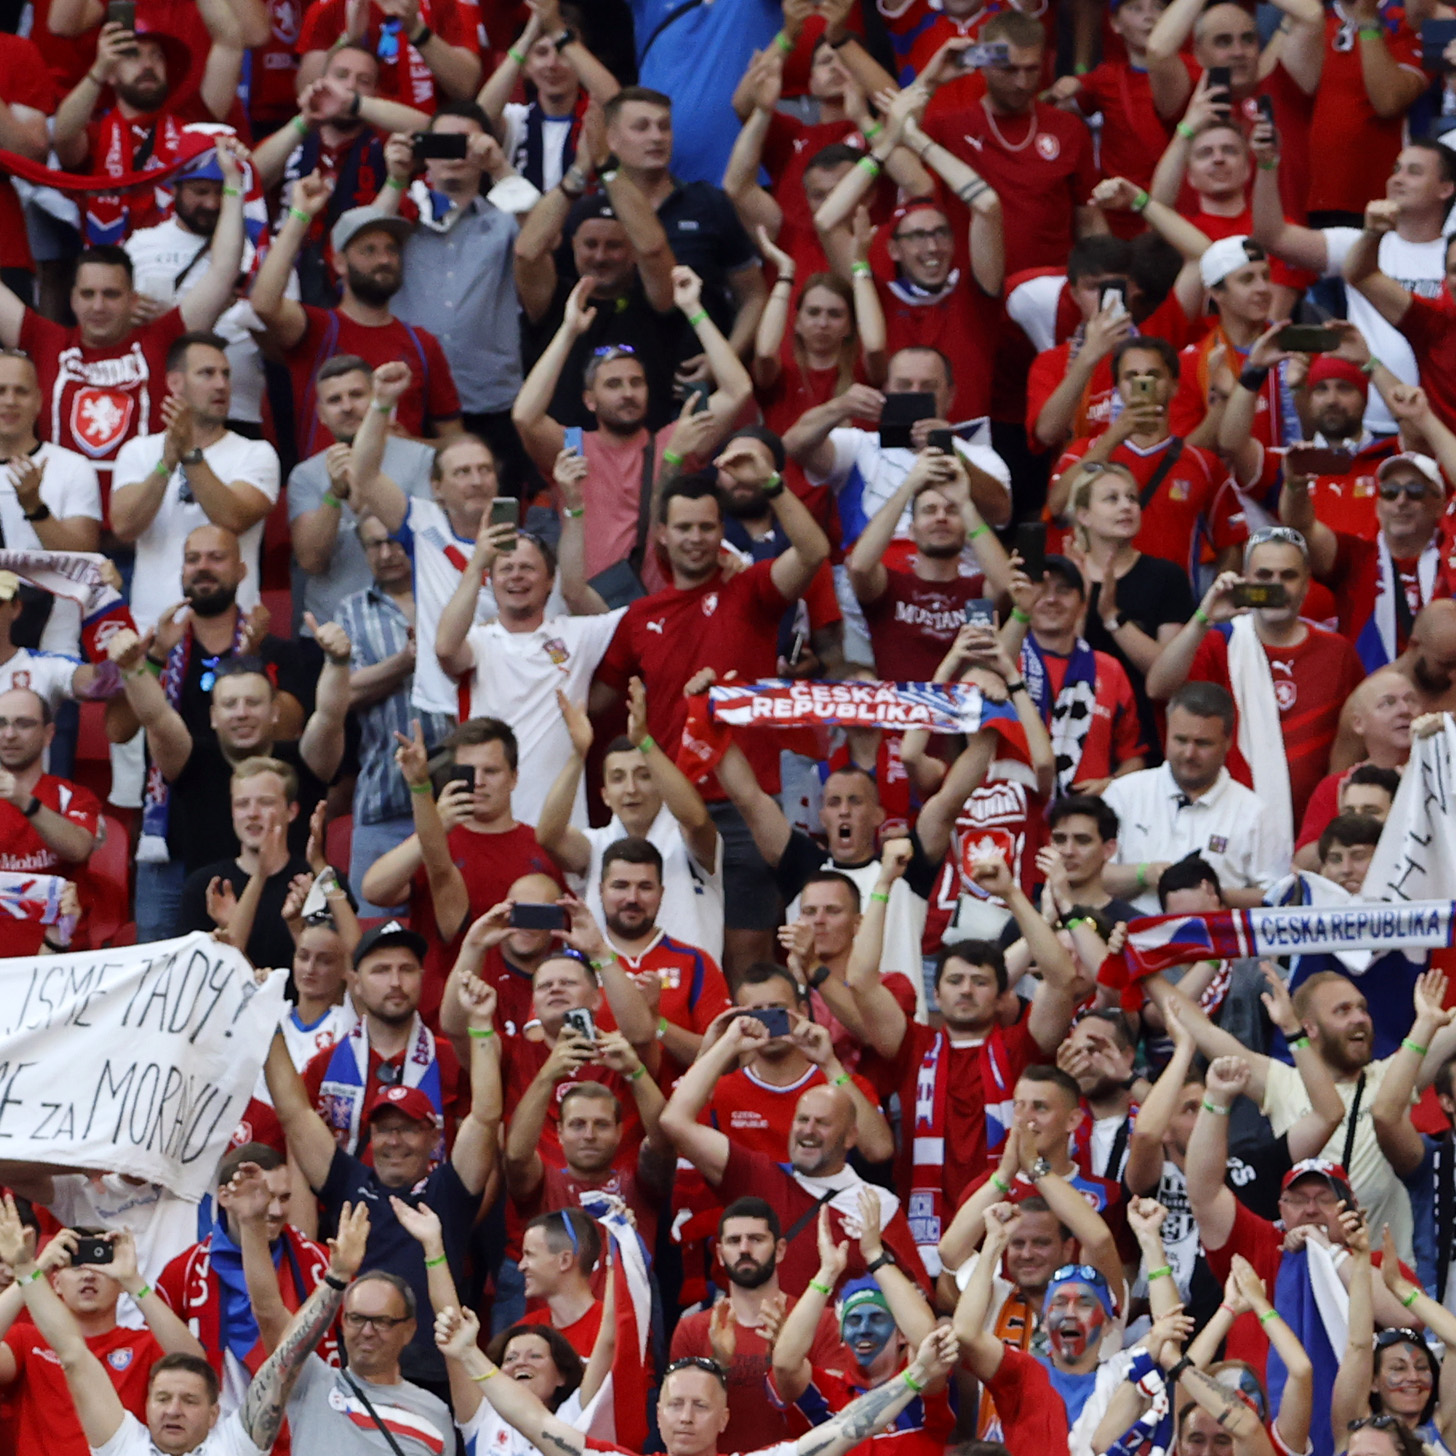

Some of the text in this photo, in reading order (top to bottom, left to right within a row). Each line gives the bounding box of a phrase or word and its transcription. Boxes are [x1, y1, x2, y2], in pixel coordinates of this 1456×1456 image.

[895, 601, 967, 631] MUSTAN
[790, 681, 897, 705] ČESKÁ
[751, 698, 930, 723] REPUBLIKA
[1331, 912, 1442, 943] REPUBLIKA
[6, 962, 124, 1040] JSME
